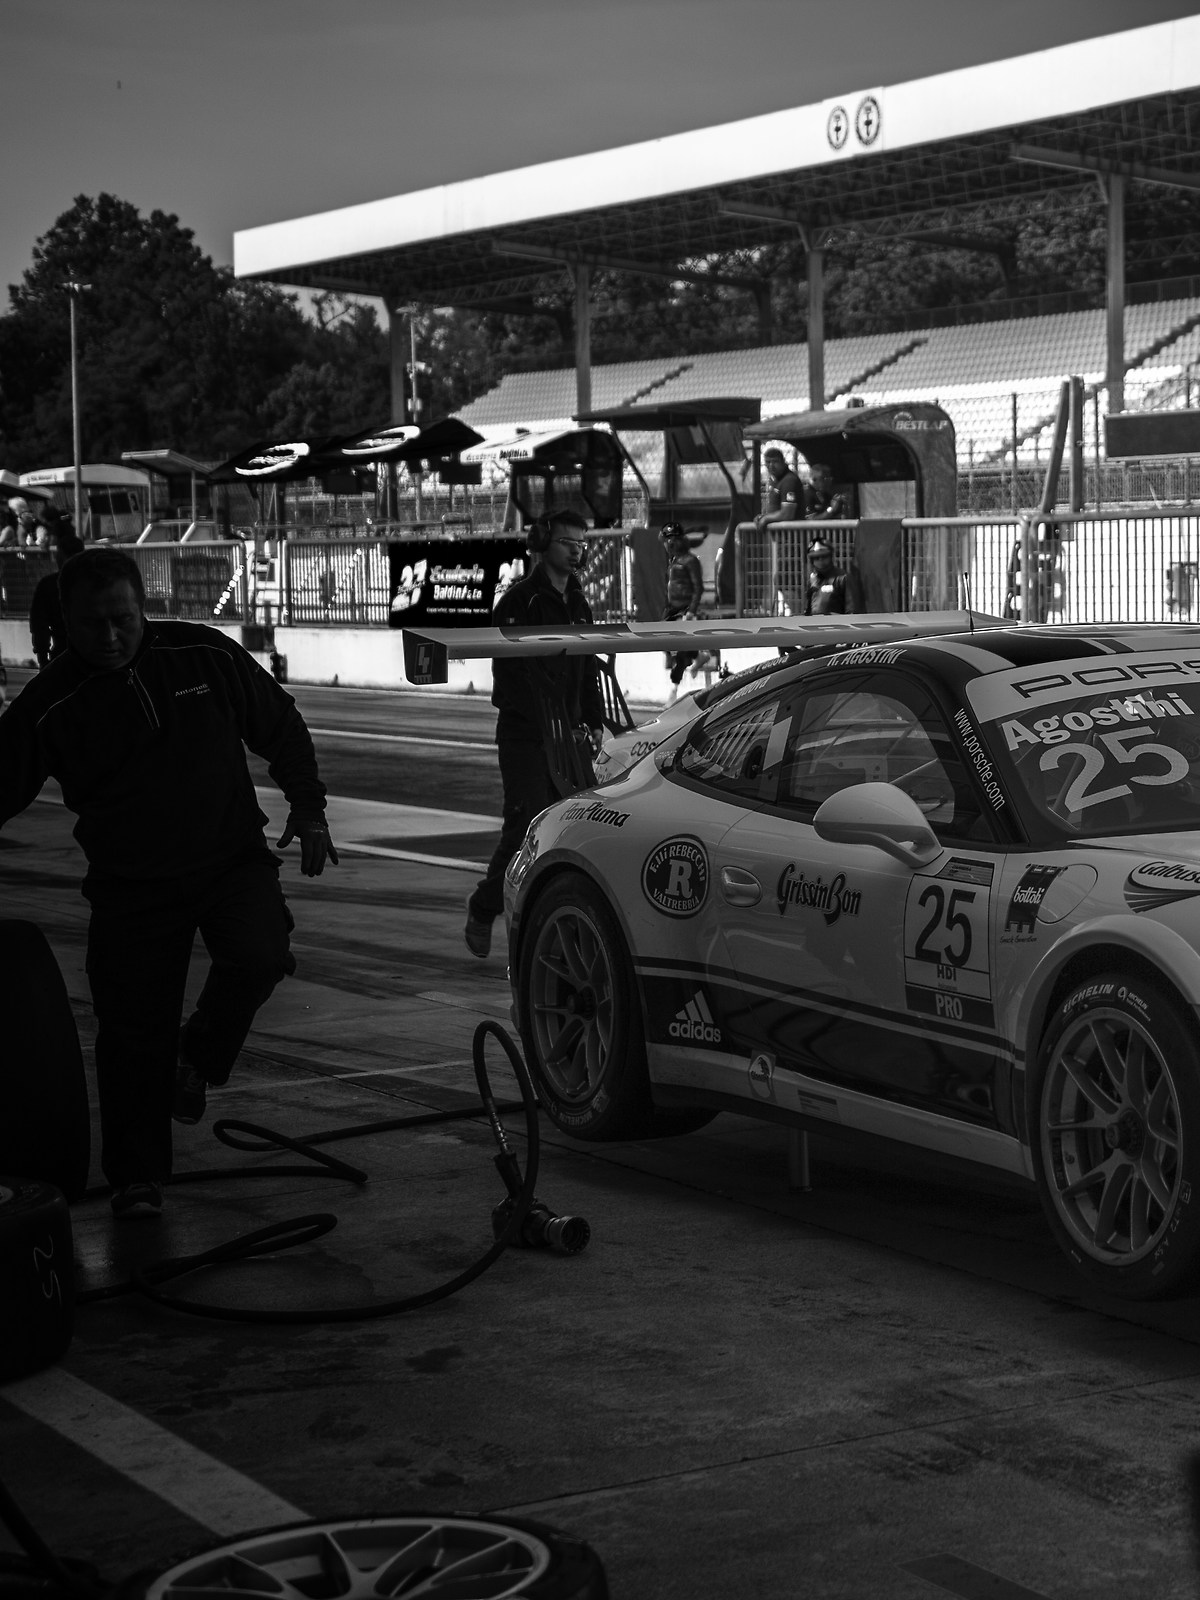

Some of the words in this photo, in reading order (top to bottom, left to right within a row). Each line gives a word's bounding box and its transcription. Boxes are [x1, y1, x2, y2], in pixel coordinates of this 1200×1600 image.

[1001, 692, 1195, 751] Agostini
[953, 706, 1006, 811] www.porsche.com
[1039, 725, 1190, 813] 25
[664, 859, 693, 898] R
[669, 843, 706, 882] REBECCHI
[652, 887, 700, 911] VALTREBBIA
[915, 884, 977, 968] 25
[936, 963, 957, 981] HDI
[935, 992, 963, 1021] PRO
[1062, 984, 1115, 1014] MICHELIN
[669, 1020, 721, 1043] adidas
